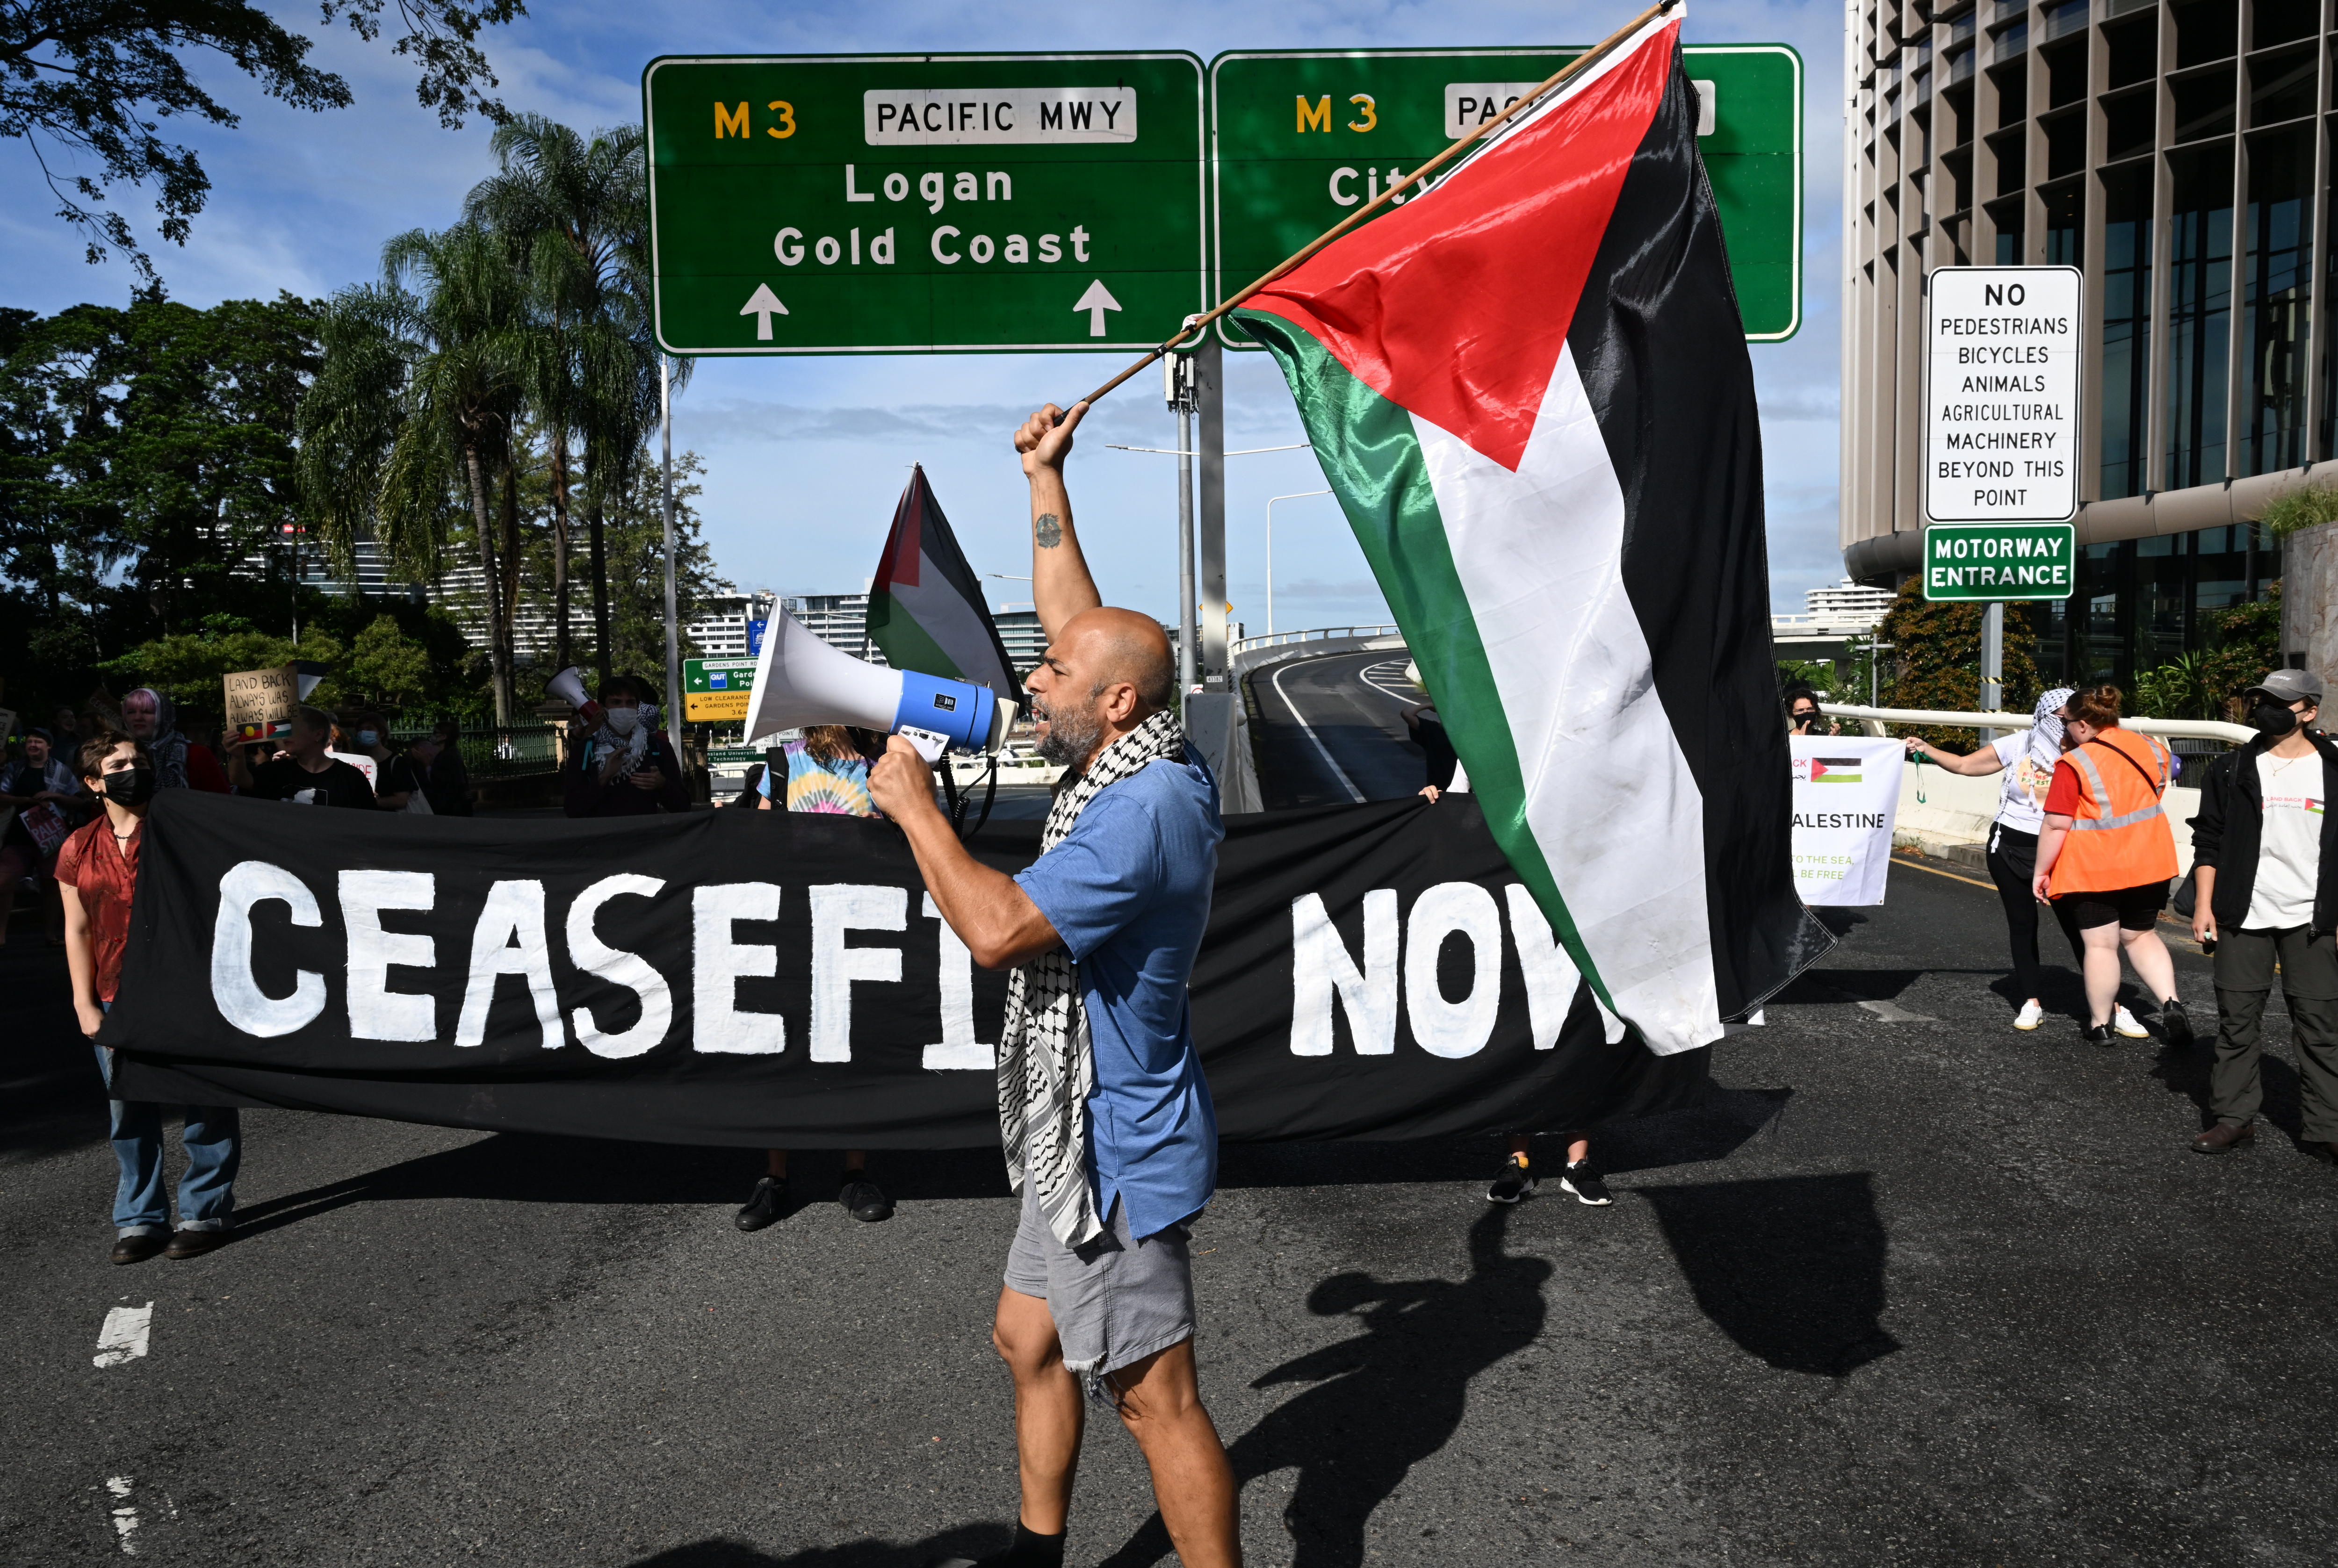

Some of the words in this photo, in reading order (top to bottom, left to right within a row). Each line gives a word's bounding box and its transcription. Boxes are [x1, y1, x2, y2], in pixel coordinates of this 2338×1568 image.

[877, 101, 1013, 132] PACIFIC
[1040, 101, 1122, 130] MWY
[846, 164, 1011, 215] Logan
[774, 227, 895, 266] Gold
[931, 224, 1090, 265] Coast
[1985, 283, 2025, 306] NO
[1941, 317, 2067, 335] PEDESTRIANS
[1959, 346, 2048, 364] BICYCLES
[1962, 375, 2045, 392] ANIMALS
[1942, 404, 2063, 421] AGRICULTURAL
[1947, 432, 2056, 449] MACHINERY
[1939, 461, 2013, 478] BEYOND
[2024, 460, 2064, 477] THIS
[1975, 489, 2027, 506] POINT
[1936, 538, 2063, 559] MOTORWAY
[1931, 565, 2067, 588] ENTRANCE
[230, 677, 257, 691] LAND
[261, 673, 291, 689] BACK
[230, 692, 265, 709] ALWAYS
[267, 690, 289, 705] WAS
[230, 708, 264, 724] ALWAYS
[266, 707, 286, 720] WILL
[287, 704, 298, 718] BE
[31, 817, 63, 842] PALE
[1830, 856, 1855, 865] SEA,
[1801, 870, 1814, 878] BE
[1817, 870, 1844, 879] FREE
